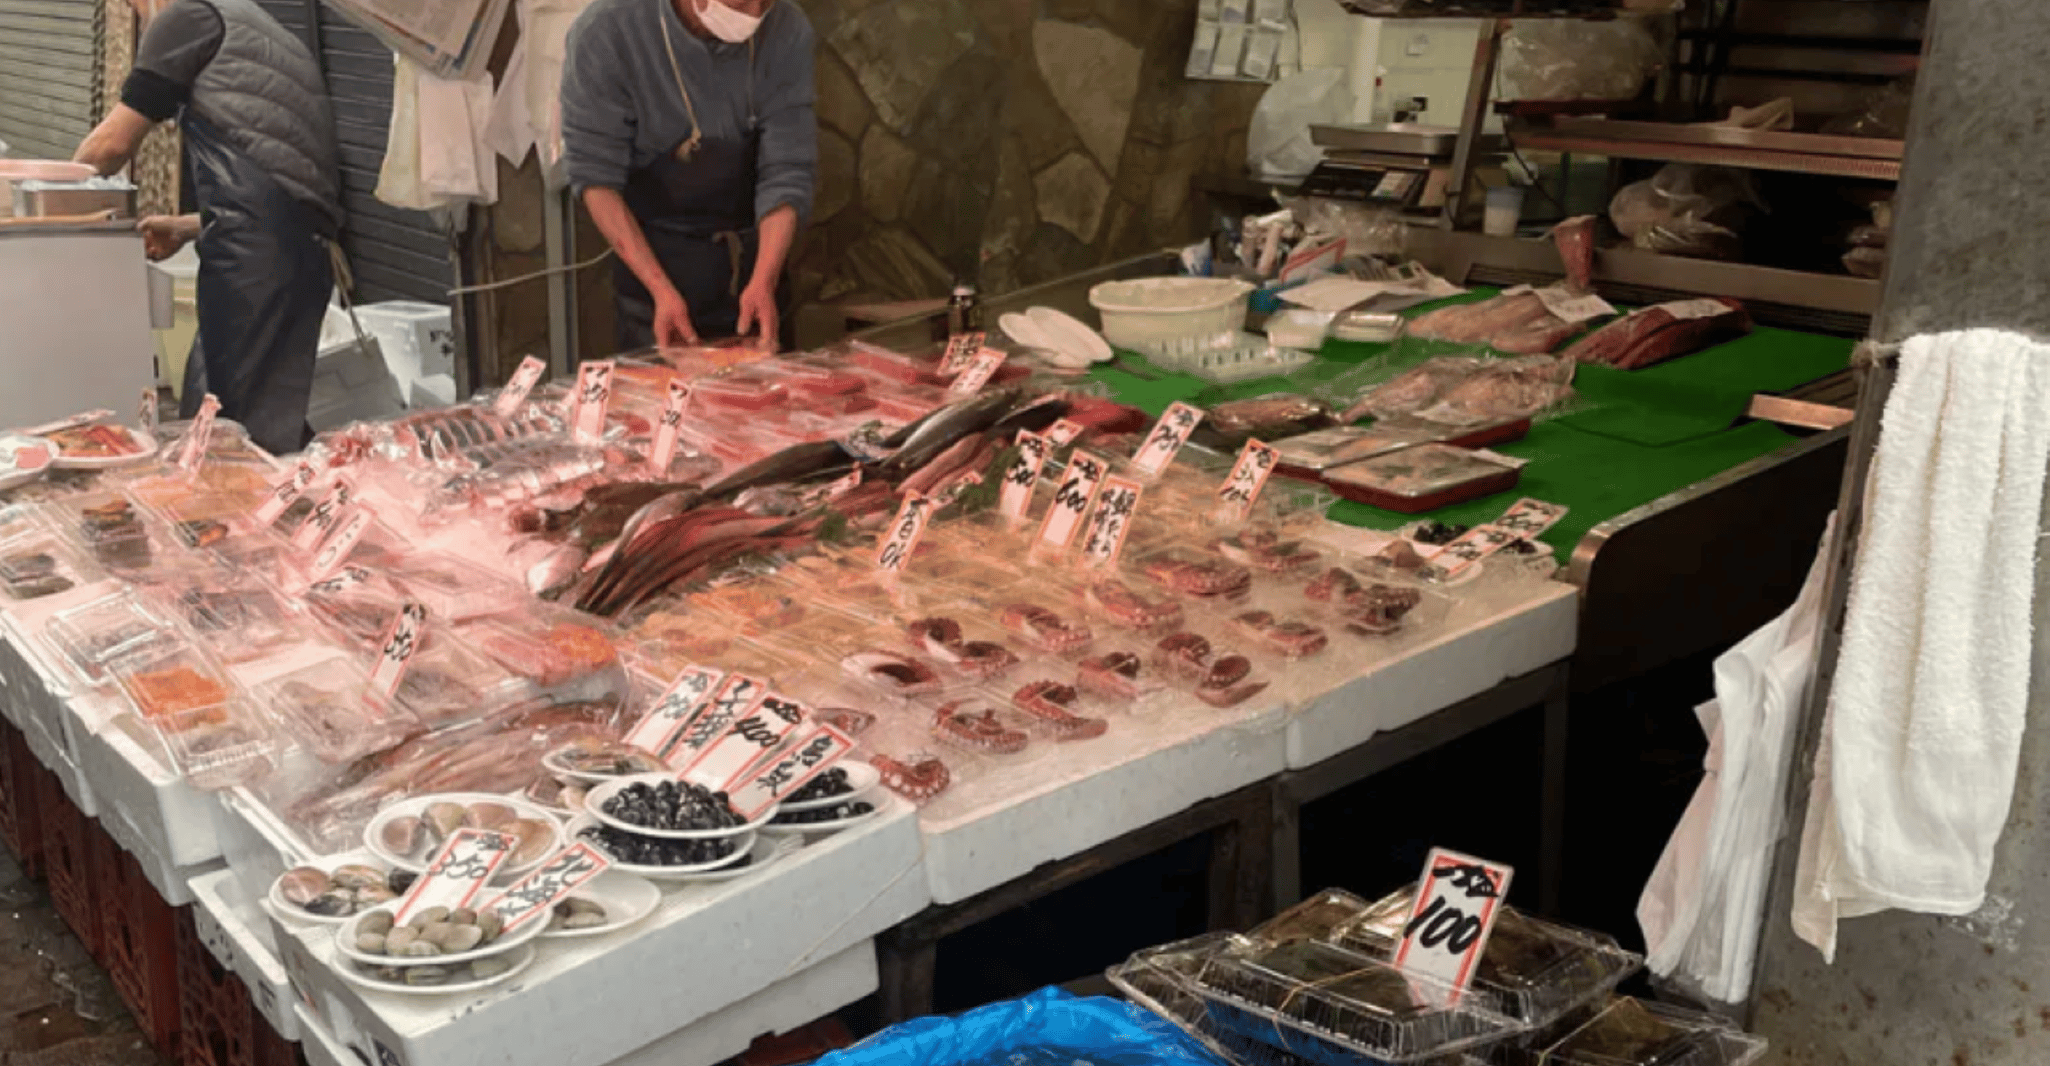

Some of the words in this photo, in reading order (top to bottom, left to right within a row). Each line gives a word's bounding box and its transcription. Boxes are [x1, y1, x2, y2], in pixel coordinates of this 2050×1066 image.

[1055, 477, 1089, 513] 600
[725, 715, 781, 747] 400
[428, 850, 490, 879] 350
[1403, 895, 1482, 955] 100
